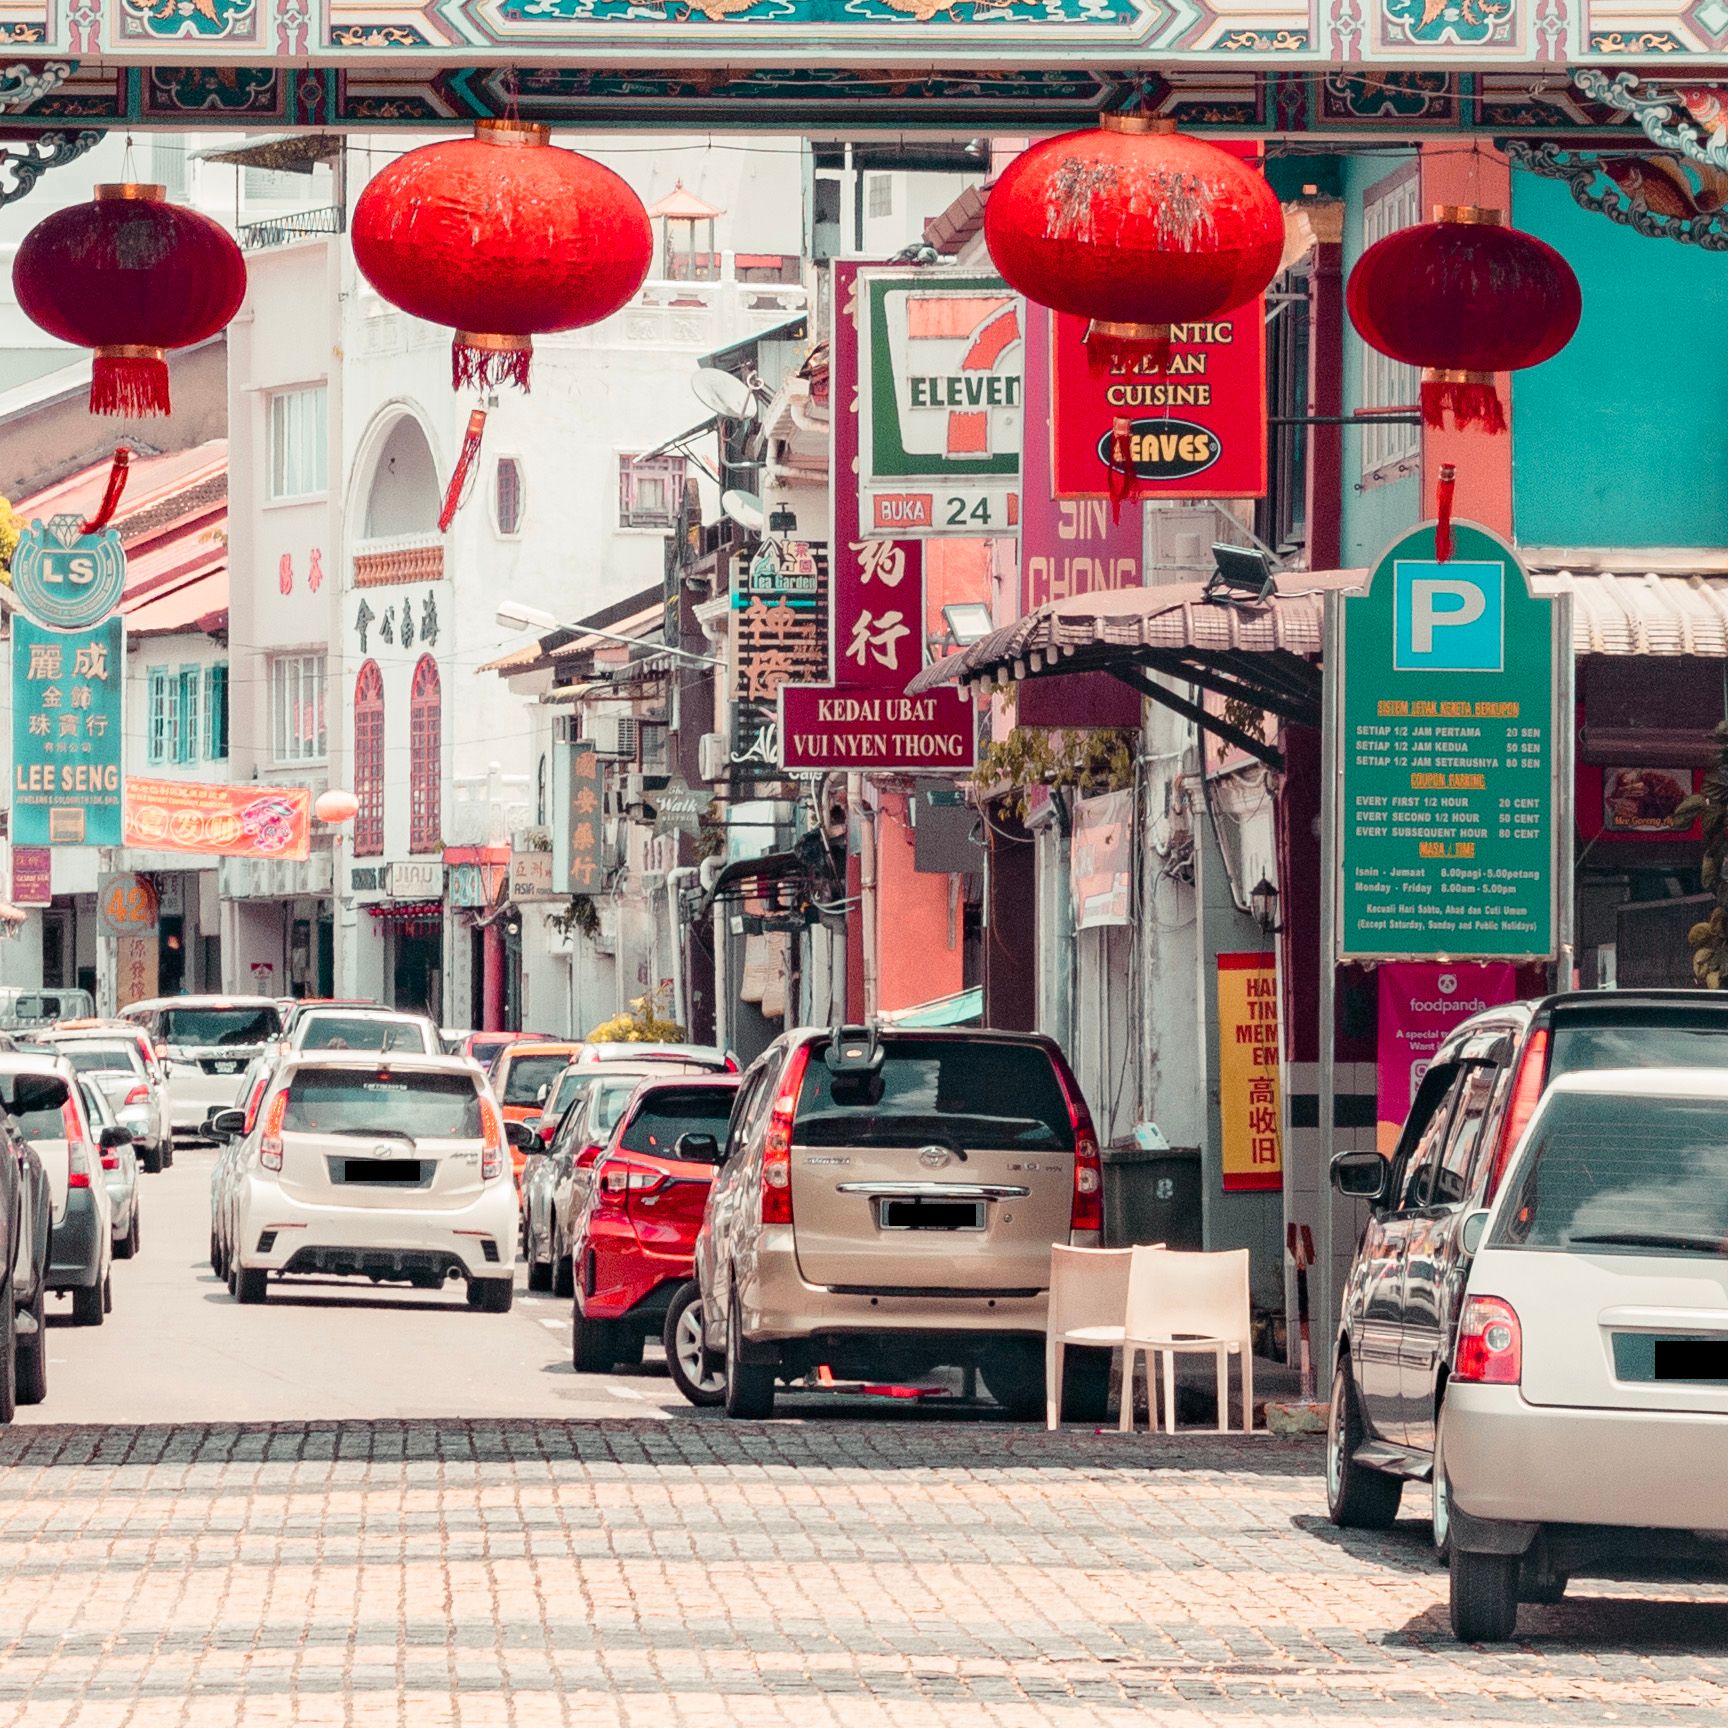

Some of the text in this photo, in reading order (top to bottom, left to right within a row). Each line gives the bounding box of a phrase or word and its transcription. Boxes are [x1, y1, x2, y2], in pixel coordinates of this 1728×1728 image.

[1107, 384, 1210, 405] CUISINE
[881, 497, 991, 525] BUKA 24
[1059, 501, 1106, 539] SIN
[752, 574, 817, 590] Tea Garden
[1412, 579, 1486, 652] P
[818, 699, 936, 721] KEDAI UBAT
[1356, 725, 1391, 736] SETIAP
[1394, 726, 1408, 737] 1/2
[1412, 726, 1432, 737] JAM
[1435, 727, 1481, 737] PERTAMA
[1521, 728, 1541, 738] SEN
[793, 735, 963, 757] VUI NYEN THONG
[1355, 740, 1390, 751] SETIAP
[1394, 741, 1408, 752] 1/2
[1411, 741, 1432, 752] JAM
[1435, 742, 1468, 752] KEDUA
[1521, 743, 1541, 753] SEN
[1355, 755, 1391, 766] SETIAP
[1394, 756, 1408, 767] 1/2
[1411, 757, 1432, 767] JAM
[1435, 757, 1499, 768] SETERUSNYA
[1521, 759, 1541, 769] SEN
[16, 764, 118, 791] LEE SENG
[1356, 796, 1540, 808] EVERY FIRST 1/2 HOUR 20 CENT
[1356, 811, 1540, 824] EVERY SECOND 1/2 HOUR 50 CENT
[1356, 826, 1387, 837] EVERY
[1392, 827, 1456, 837] SUBSEQUENT
[1460, 828, 1488, 838] HOUR
[1514, 828, 1540, 839] CENT
[1356, 866, 1379, 877] Isnin
[1390, 866, 1425, 877] Jumaat
[1355, 882, 1391, 894] Monday
[1403, 882, 1432, 894] Friday
[107, 887, 148, 922] 42
[1410, 997, 1486, 1015] foodpanda
[1396, 1029, 1404, 1039] A
[1405, 1029, 1438, 1041] special
[1410, 1041, 1435, 1051] Want
